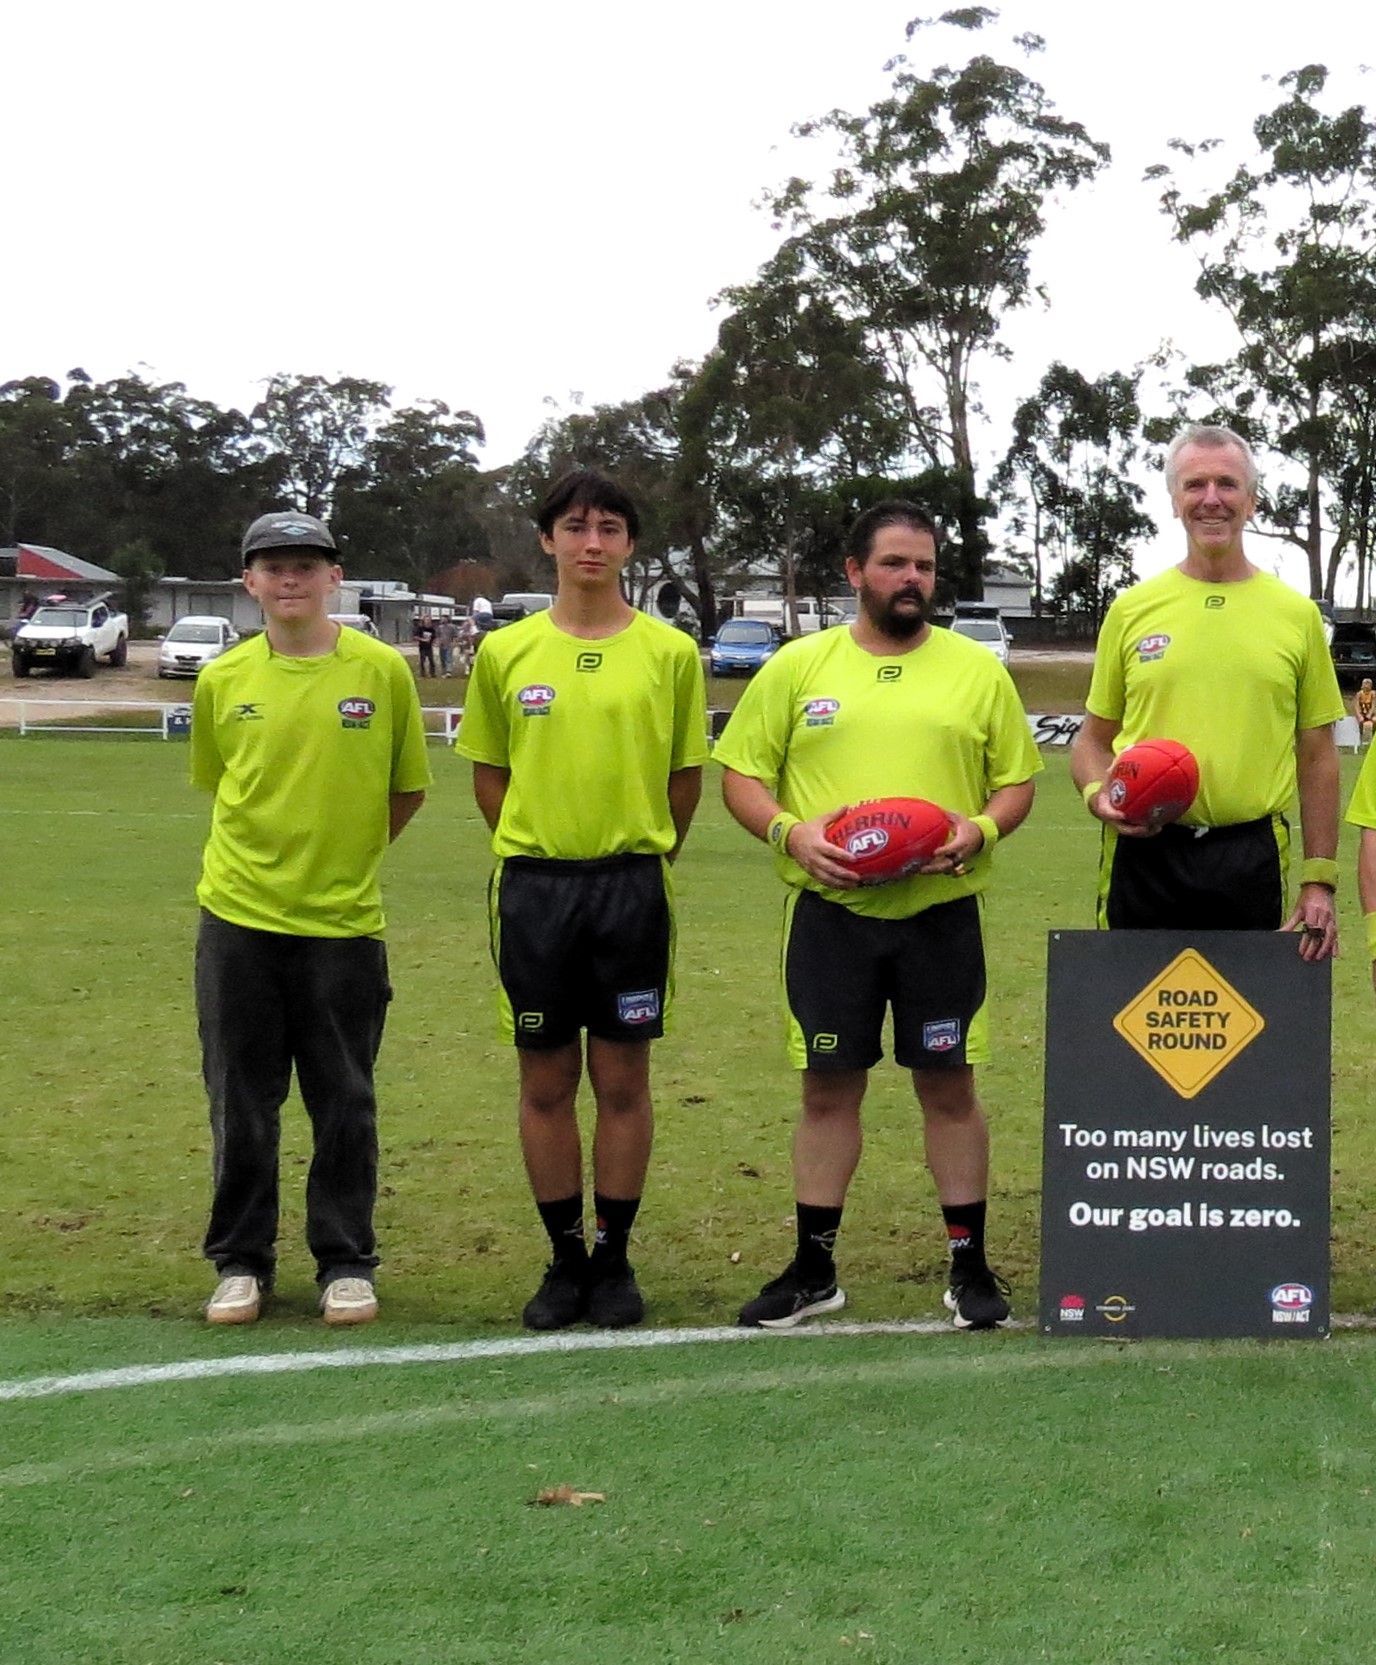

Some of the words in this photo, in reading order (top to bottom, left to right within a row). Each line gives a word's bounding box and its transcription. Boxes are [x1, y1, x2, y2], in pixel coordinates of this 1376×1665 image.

[521, 689, 553, 701] AFL
[341, 702, 372, 714] AFL
[852, 832, 885, 855] AFL
[1158, 990, 1218, 1007] ROAD
[624, 1006, 657, 1020] AFL
[1145, 1011, 1231, 1028] SAFETY
[928, 1035, 957, 1047] AFL
[1147, 1033, 1227, 1050] ROUND
[1059, 1123, 1107, 1147] Too
[1113, 1129, 1187, 1151] many
[1193, 1124, 1255, 1148] lives
[1262, 1125, 1313, 1148] lost
[1086, 1162, 1119, 1179] on
[1127, 1157, 1195, 1180] NSW
[1201, 1157, 1285, 1180] roads.
[1069, 1202, 1124, 1226] Our
[1129, 1202, 1193, 1231] goal
[1200, 1203, 1224, 1227] is
[1229, 1208, 1300, 1227] zero.
[1273, 1289, 1312, 1303] AFL
[1060, 1308, 1085, 1317] NSW
